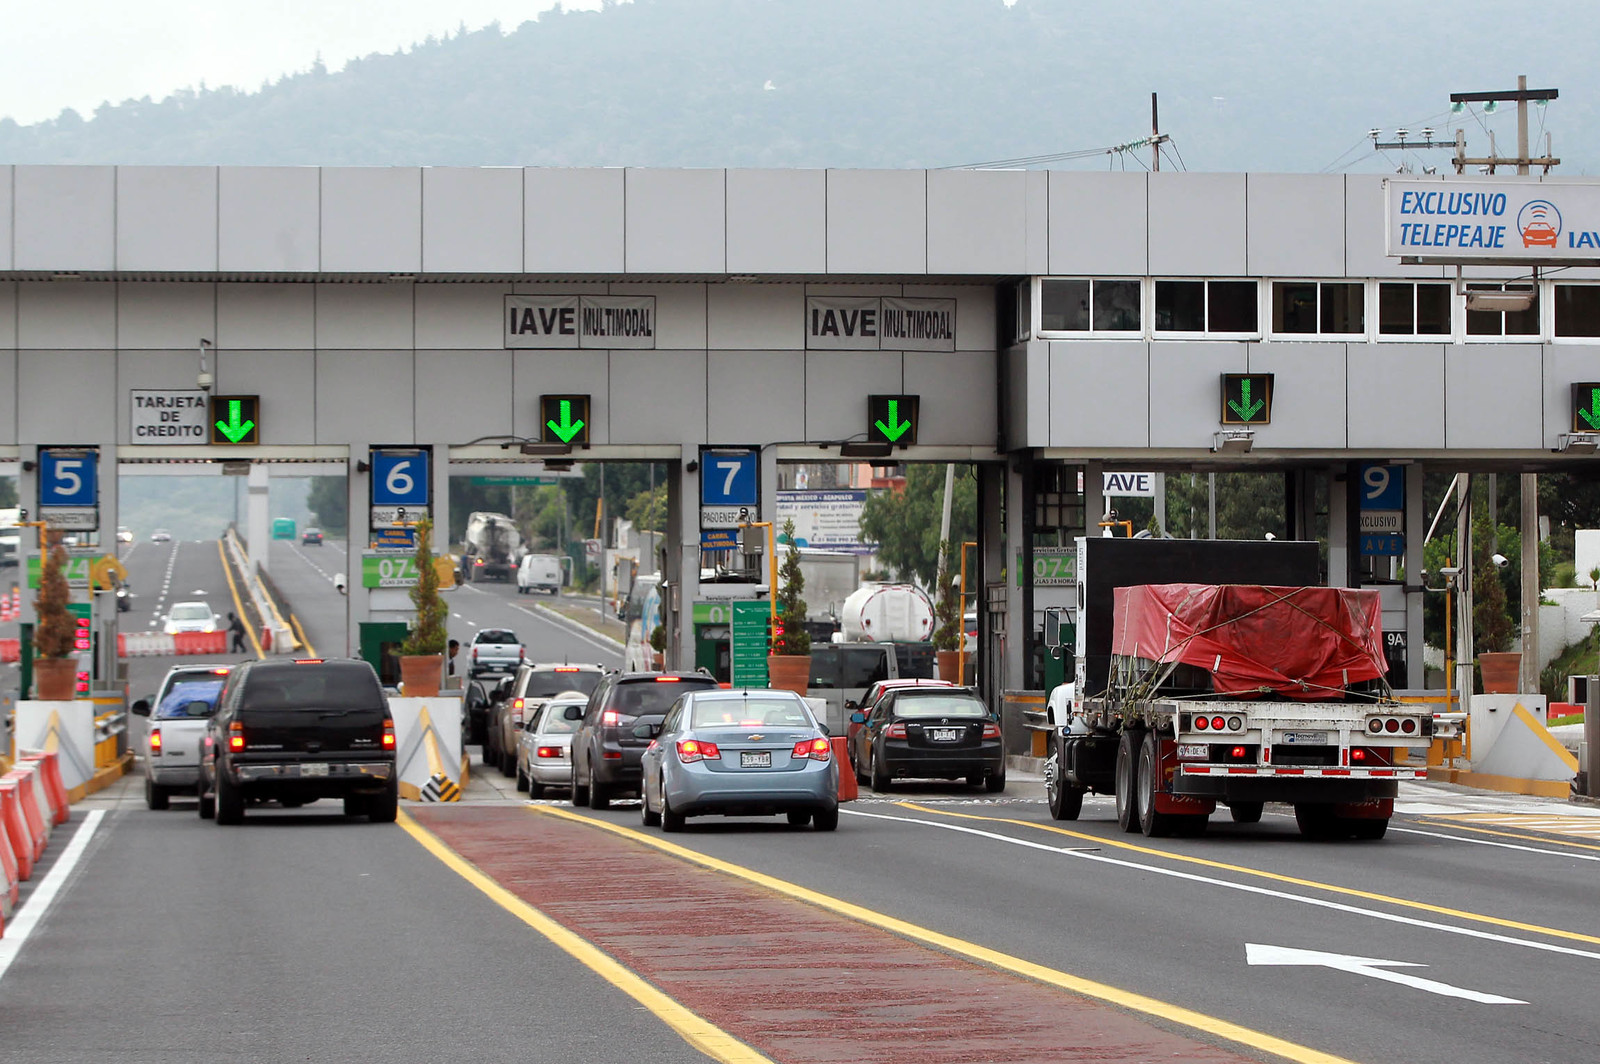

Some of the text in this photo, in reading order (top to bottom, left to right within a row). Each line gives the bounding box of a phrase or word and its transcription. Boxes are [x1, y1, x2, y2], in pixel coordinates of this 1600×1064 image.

[1400, 191, 1507, 216] EXCLUSIVO
[1400, 223, 1507, 248] TELEPEAJE
[510, 307, 652, 337] IAVE MULTIMODAL
[812, 309, 952, 339] IAVE MULTIMODAL
[135, 396, 206, 408] TARJETA
[160, 411, 180, 422] DE
[136, 425, 204, 437] CREDITO
[53, 460, 82, 496] 5
[386, 460, 414, 495] 6
[717, 461, 741, 495] 7
[1363, 466, 1390, 500] 9
[1360, 516, 1397, 528] XCLUSIVO
[1366, 539, 1398, 551] AVE
[1033, 558, 1077, 579] 074
[1387, 633, 1404, 646] 9A
